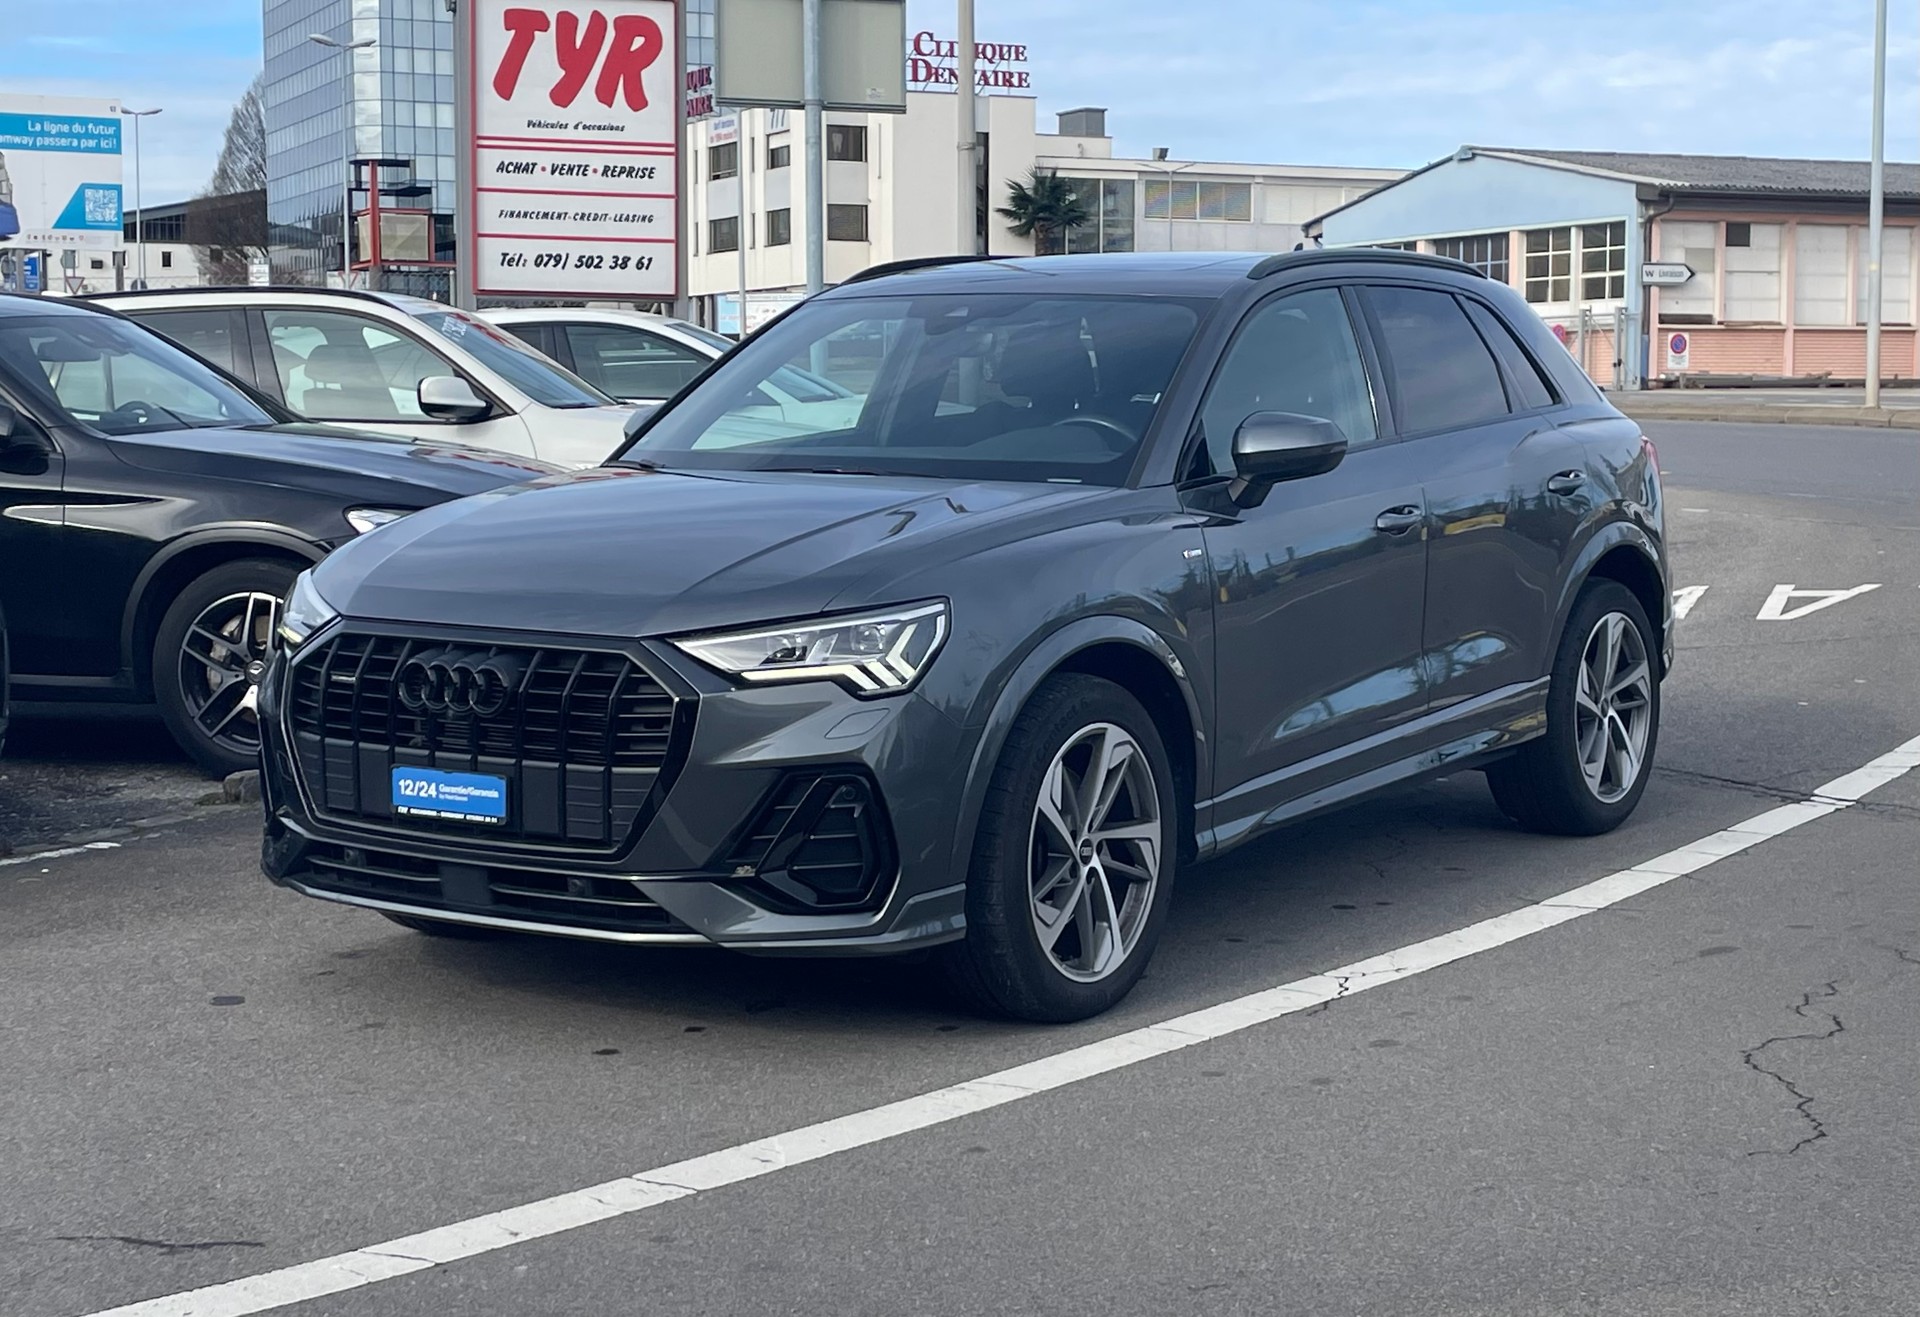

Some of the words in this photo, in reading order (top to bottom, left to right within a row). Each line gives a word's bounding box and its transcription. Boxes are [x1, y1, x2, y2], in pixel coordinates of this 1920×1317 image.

[913, 31, 1027, 64] CLIIQUE
[493, 8, 663, 112] TYR
[908, 58, 1030, 88] DENAIRE
[28, 120, 42, 132] La
[44, 121, 69, 134] ligne
[72, 122, 85, 133] du
[88, 123, 117, 134] futur
[527, 119, 569, 130] Véhicules
[573, 121, 625, 132] d'occasions
[36, 136, 78, 147] passera
[80, 138, 98, 149] par
[496, 160, 537, 175] ACHAT
[550, 163, 590, 177] VENTE
[601, 165, 656, 180] REPRISE
[500, 252, 528, 268] Tél:
[574, 255, 604, 269] 502
[609, 255, 631, 270] 38
[635, 256, 654, 271] 61
[398, 778, 437, 799] 12/24
